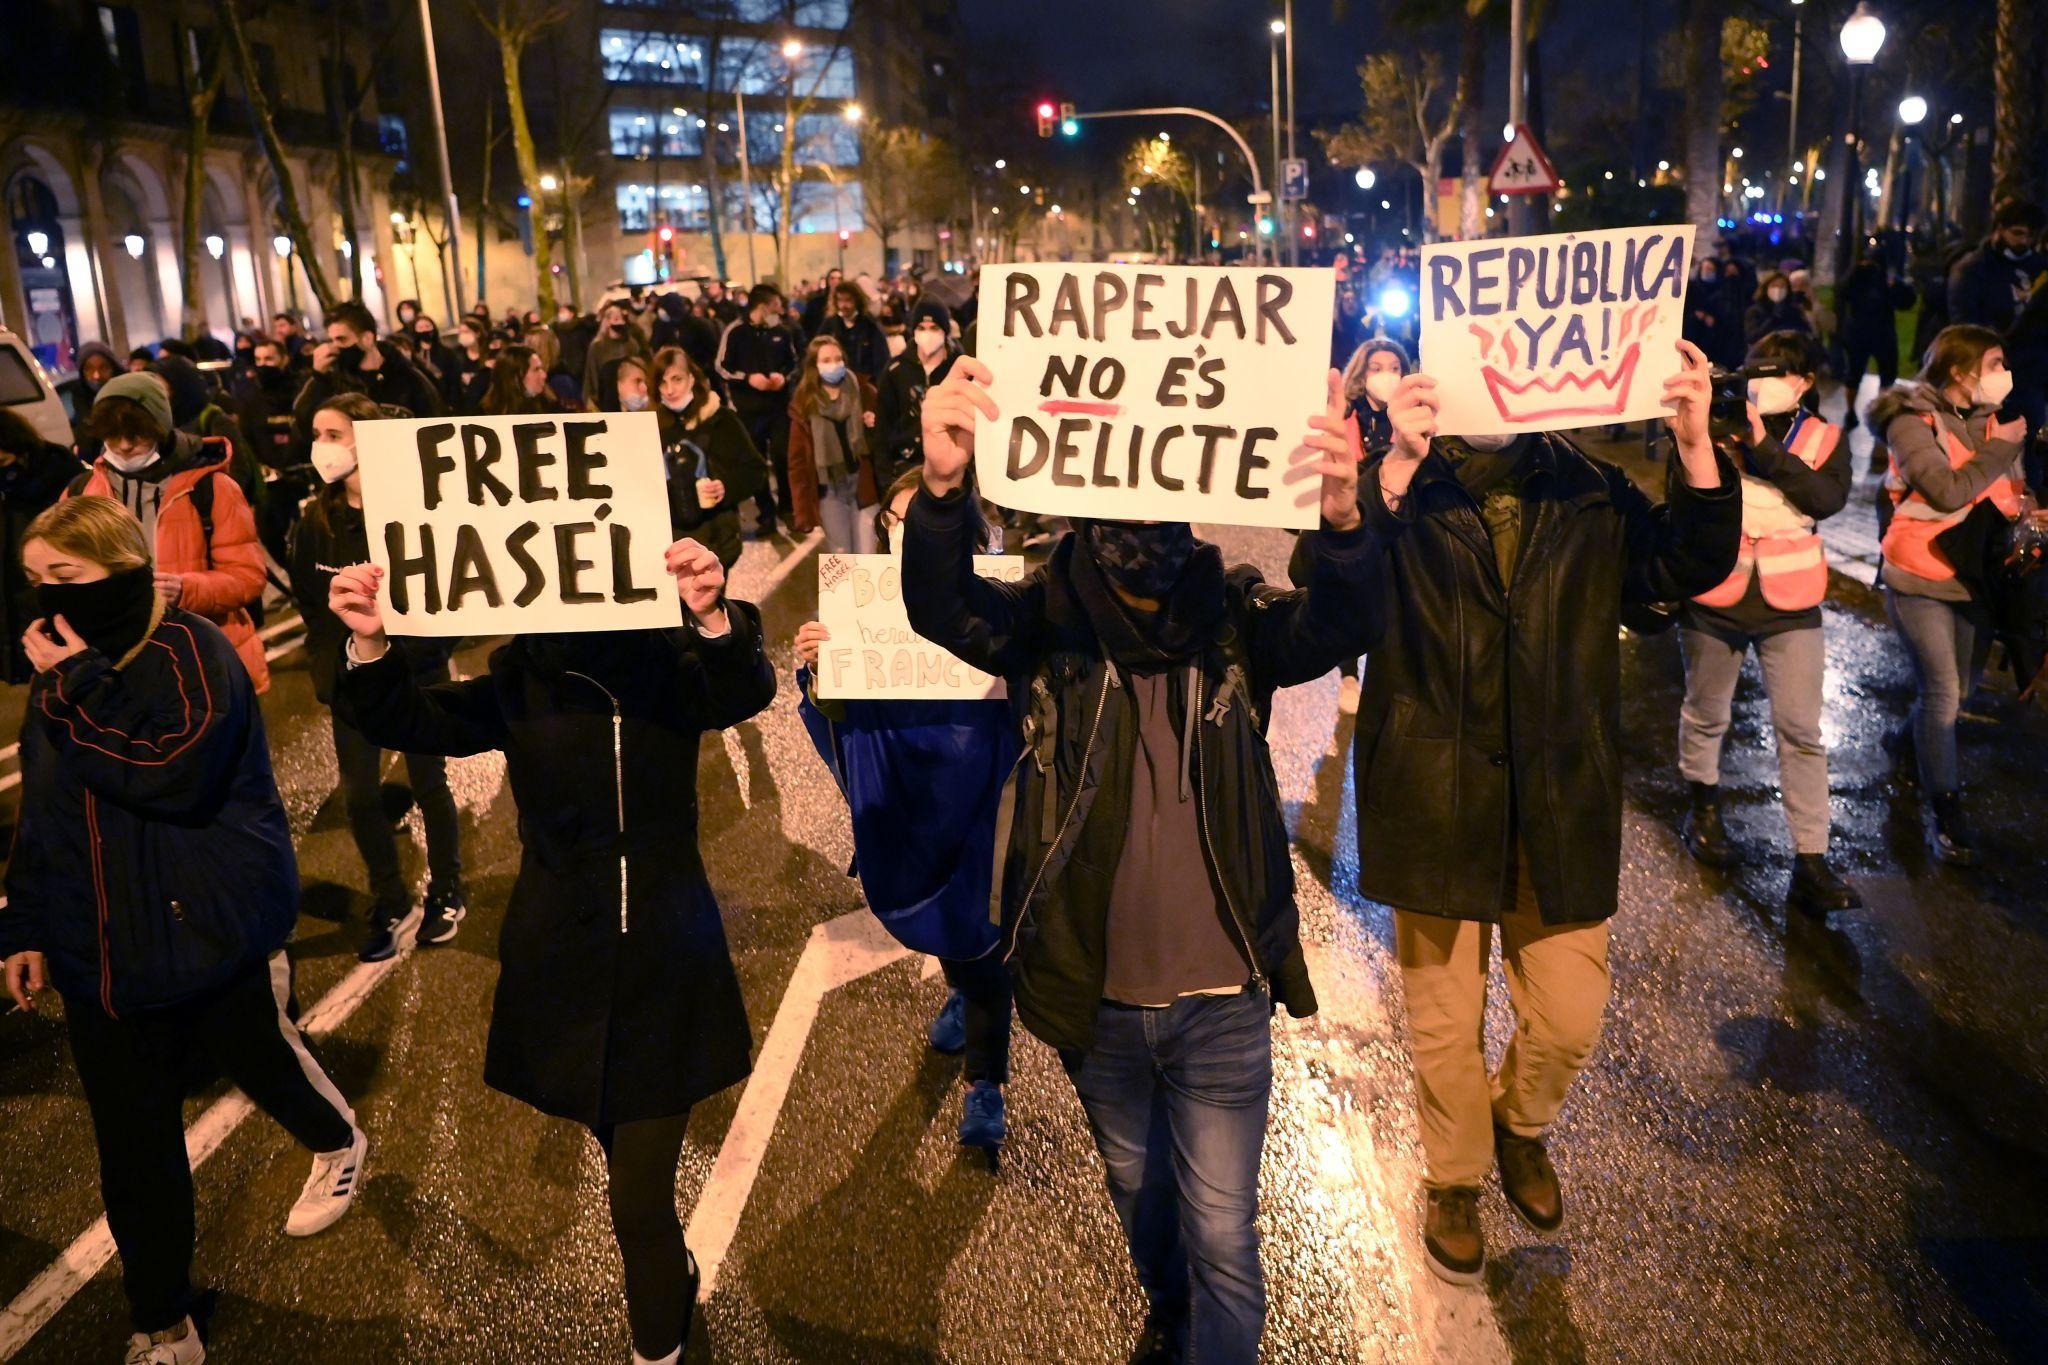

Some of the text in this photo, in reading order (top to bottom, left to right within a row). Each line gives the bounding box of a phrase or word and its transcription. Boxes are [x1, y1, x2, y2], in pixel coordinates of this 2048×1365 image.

[1003, 271, 1297, 345] RAPEJAR
[1428, 234, 1684, 321] REPÚBLICA
[1040, 344, 1226, 409] NO ÉS
[1514, 307, 1612, 371] YA!
[416, 420, 613, 510] FREE
[1006, 415, 1279, 499] DELICTE
[385, 503, 657, 615] HASÉL
[820, 555, 842, 579] FREE
